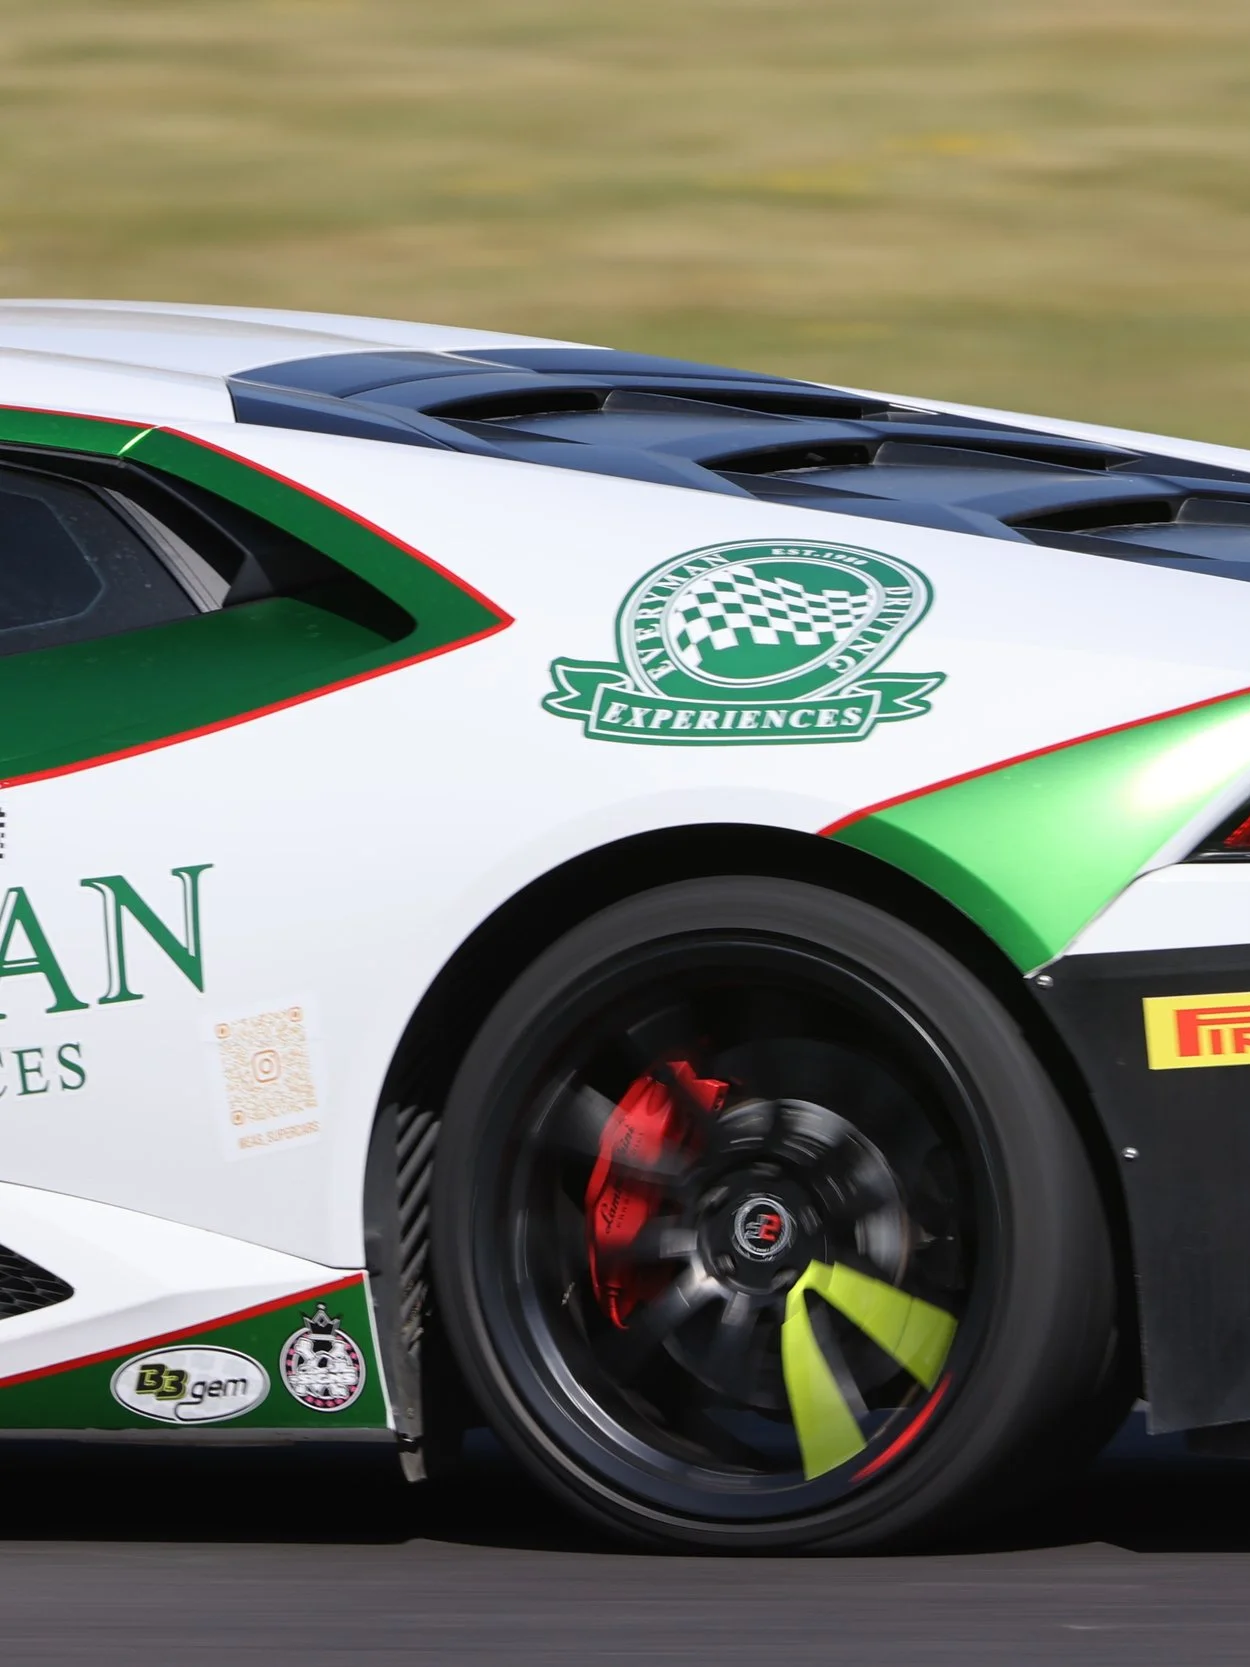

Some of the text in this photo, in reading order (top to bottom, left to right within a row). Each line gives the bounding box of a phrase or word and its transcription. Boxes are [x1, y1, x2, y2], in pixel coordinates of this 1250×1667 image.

[635, 553, 732, 681] EVERYMAN
[826, 586, 912, 673] DRIVING
[600, 701, 863, 730] EXPERIENCES
[0, 1042, 87, 1097] ES
